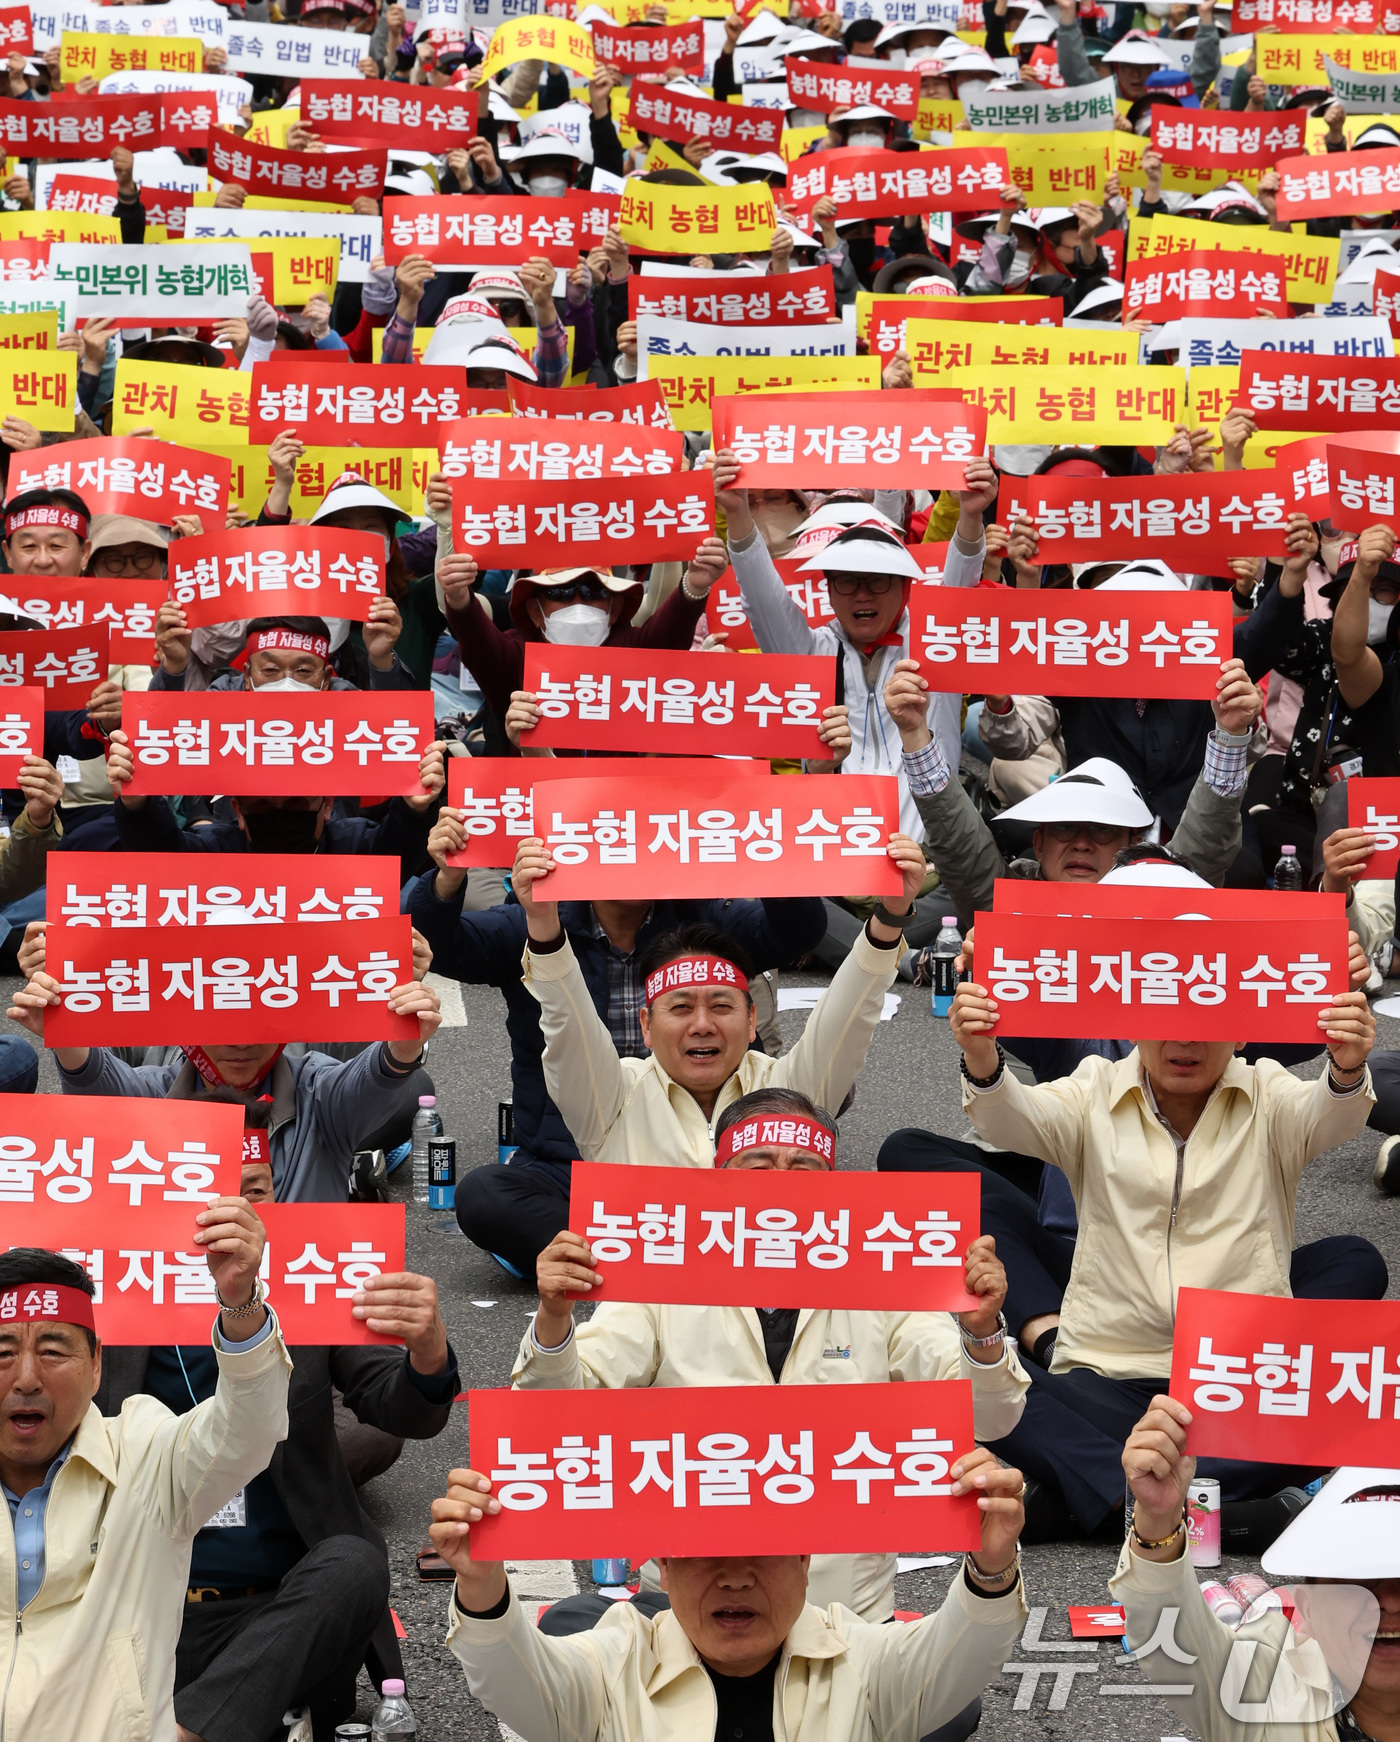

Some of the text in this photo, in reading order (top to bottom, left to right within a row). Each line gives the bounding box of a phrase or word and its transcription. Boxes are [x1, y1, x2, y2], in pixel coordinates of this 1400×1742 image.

[65, 46, 195, 72] 관치 농협 반대
[228, 35, 361, 68] 졸속 입법 반대
[1263, 48, 1300, 70] 관치
[1362, 49, 1397, 70] 반대
[790, 71, 913, 104] 농협 자율성 수호
[33, 110, 155, 142] 자율성 수호
[170, 106, 212, 132] 수호
[308, 93, 470, 131] 농협 자율성 수호
[635, 94, 671, 124] 농협
[674, 111, 730, 138] 자율성
[735, 119, 775, 142] 수호
[1156, 121, 1193, 150] 농협
[1197, 124, 1261, 153] 자율성
[1264, 124, 1300, 152] 수호
[212, 142, 379, 190] 농협 자율성 수호
[831, 161, 1005, 200] 농협 자율성 수호
[1048, 164, 1096, 192] 반대
[1283, 170, 1331, 202] 농협
[390, 213, 575, 248] 농협 자율성 수호
[619, 196, 776, 234] 관치 농협 반대
[155, 263, 251, 297] 농협개혁
[290, 256, 334, 286] 반대
[1127, 268, 1281, 306] 농협 자율성 수호
[692, 294, 772, 322] 자율성
[777, 285, 830, 319] 수호
[914, 340, 972, 375] 관치
[13, 371, 67, 408] 반대
[122, 381, 178, 420] 관치
[257, 383, 461, 425] 농협 자율성 수호
[1035, 386, 1175, 423] 농협 반대
[1248, 372, 1310, 412] 농협
[442, 440, 501, 480] 농협
[507, 441, 604, 481] 자율성
[730, 425, 976, 465] 농협 자율성 수호
[76, 457, 221, 512] 자율성 수호
[1336, 469, 1395, 516] 농협
[462, 495, 711, 546] 농협 자율성 수호
[1034, 493, 1288, 539] 농협 자율성 수호
[174, 550, 381, 604] 농협 자율성 수호
[92, 602, 156, 640] 수호
[922, 615, 1221, 668] 농협 자율성 수호
[33, 647, 100, 688] 수호
[535, 671, 821, 728] 농협 자율성 수호
[135, 719, 422, 766] 농협 자율성 수호
[463, 787, 534, 837] 농협
[547, 806, 888, 864] 농협 자율성 수호
[60, 950, 405, 1013] 농협 자율성 수호
[646, 961, 737, 1001] 농협 자율성 수호
[988, 947, 1334, 1008] 농협 자율성 수호
[731, 1120, 834, 1162] 농협 자율성 수호
[108, 1140, 221, 1206] 수호
[585, 1201, 963, 1272] 농협 자율성 수호
[284, 1241, 387, 1305] 수호
[23, 1290, 59, 1319] 수호
[1189, 1336, 1400, 1420] 농협 자
[490, 1427, 954, 1511] 농협 자율성 수호
